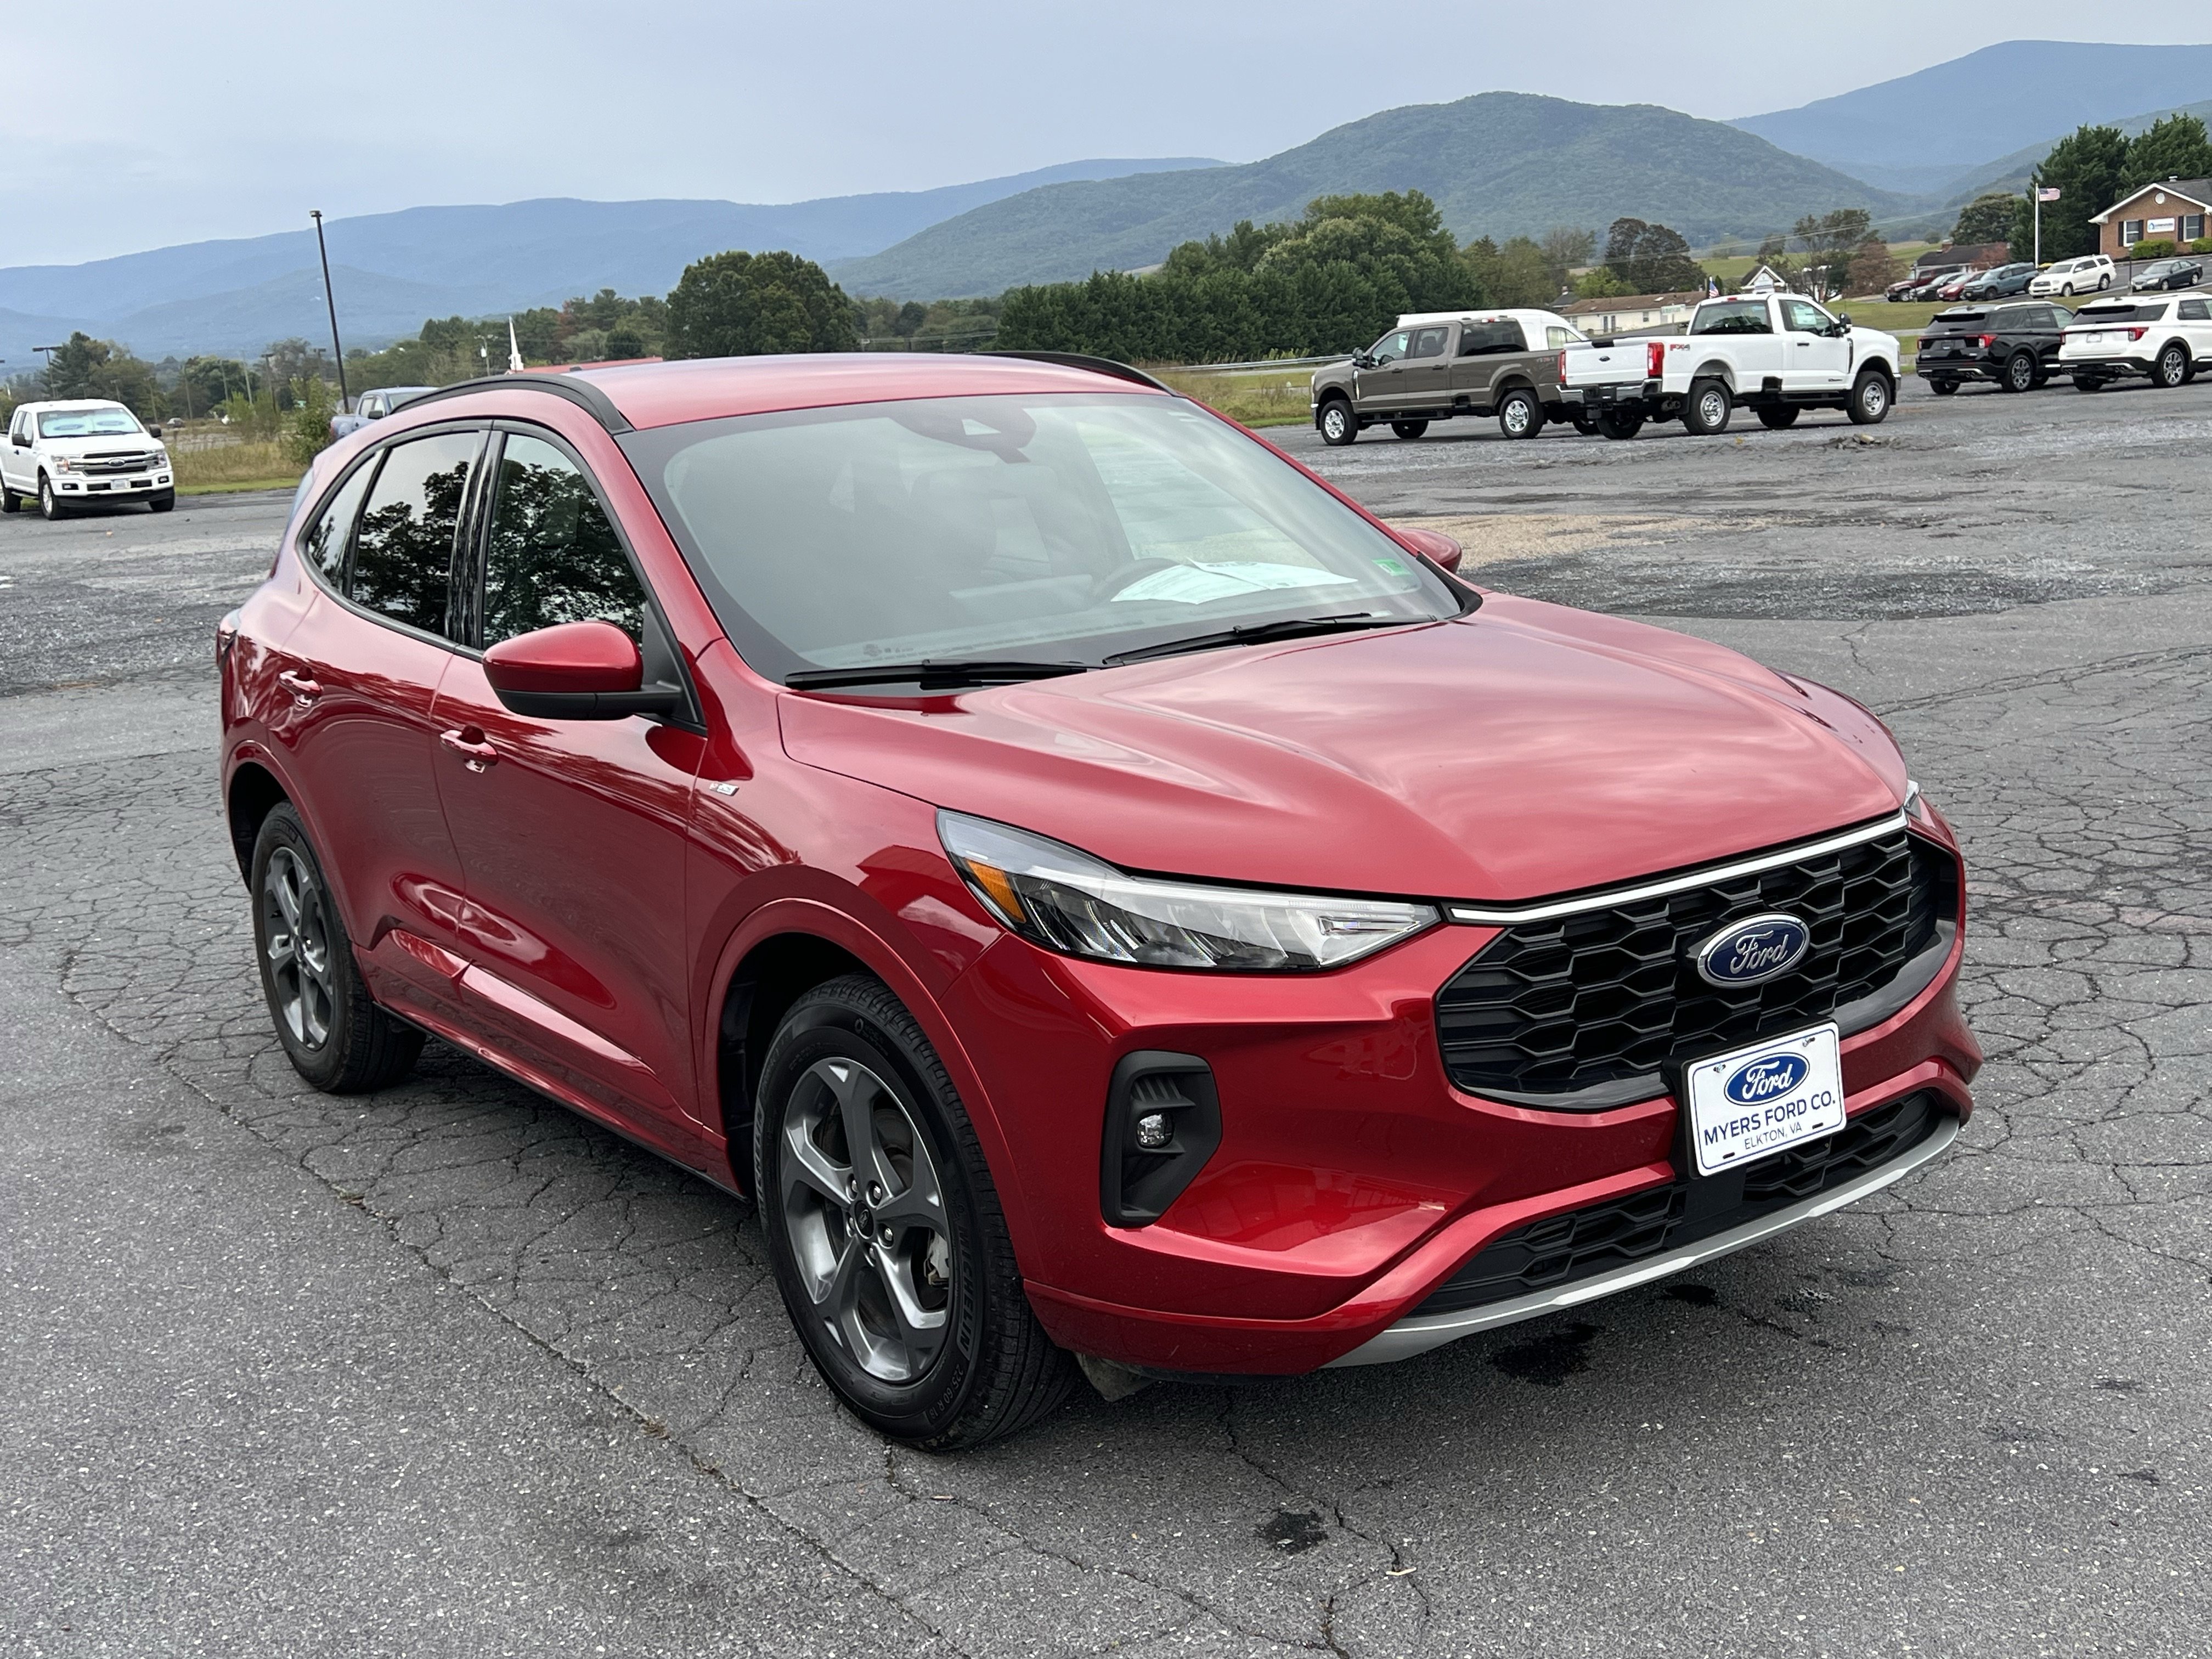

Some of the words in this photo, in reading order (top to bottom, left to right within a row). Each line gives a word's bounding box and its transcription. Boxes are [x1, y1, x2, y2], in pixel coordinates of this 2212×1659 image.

[1730, 930, 1789, 974] Ford
[1742, 1060, 1793, 1099] Ford
[1704, 1114, 1761, 1146] MYERS
[1765, 1099, 1807, 1127] FORD
[1811, 1091, 1836, 1114] CO.
[1745, 1127, 1787, 1150] ELKTON,
[1789, 1122, 1802, 1134] VA
[958, 1224, 974, 1352] MICHELIN
